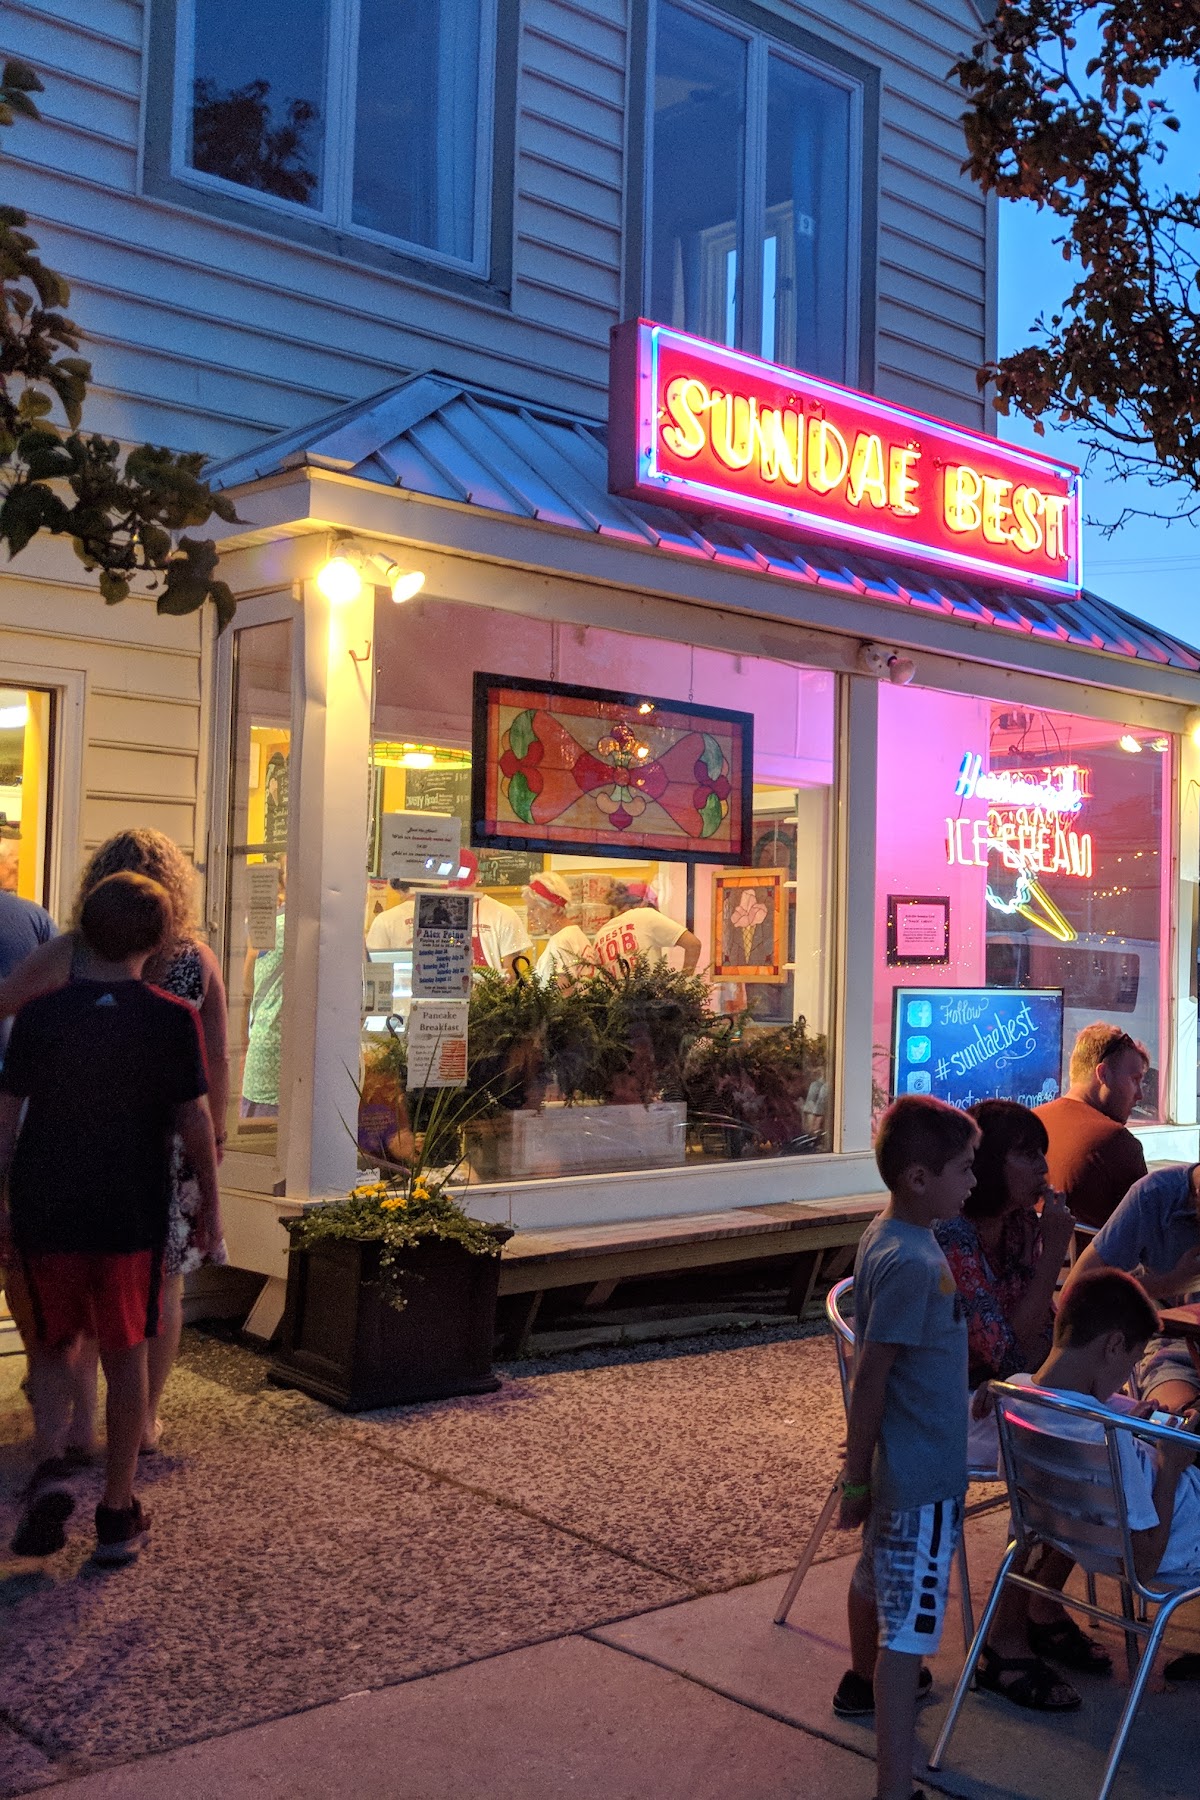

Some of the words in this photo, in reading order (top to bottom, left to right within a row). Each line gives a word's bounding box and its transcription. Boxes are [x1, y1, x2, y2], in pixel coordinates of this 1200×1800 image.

[661, 377, 921, 516] SUNDAE
[944, 465, 1071, 560] BEST
[945, 818, 989, 867] ICE
[1001, 821, 1093, 878] CREAM
[423, 930, 441, 939] Alex
[423, 1011, 457, 1020] Pancake
[939, 996, 990, 1026] Follow
[420, 1023, 459, 1031] Breakfast
[934, 1000, 1040, 1081] #sundaebest
